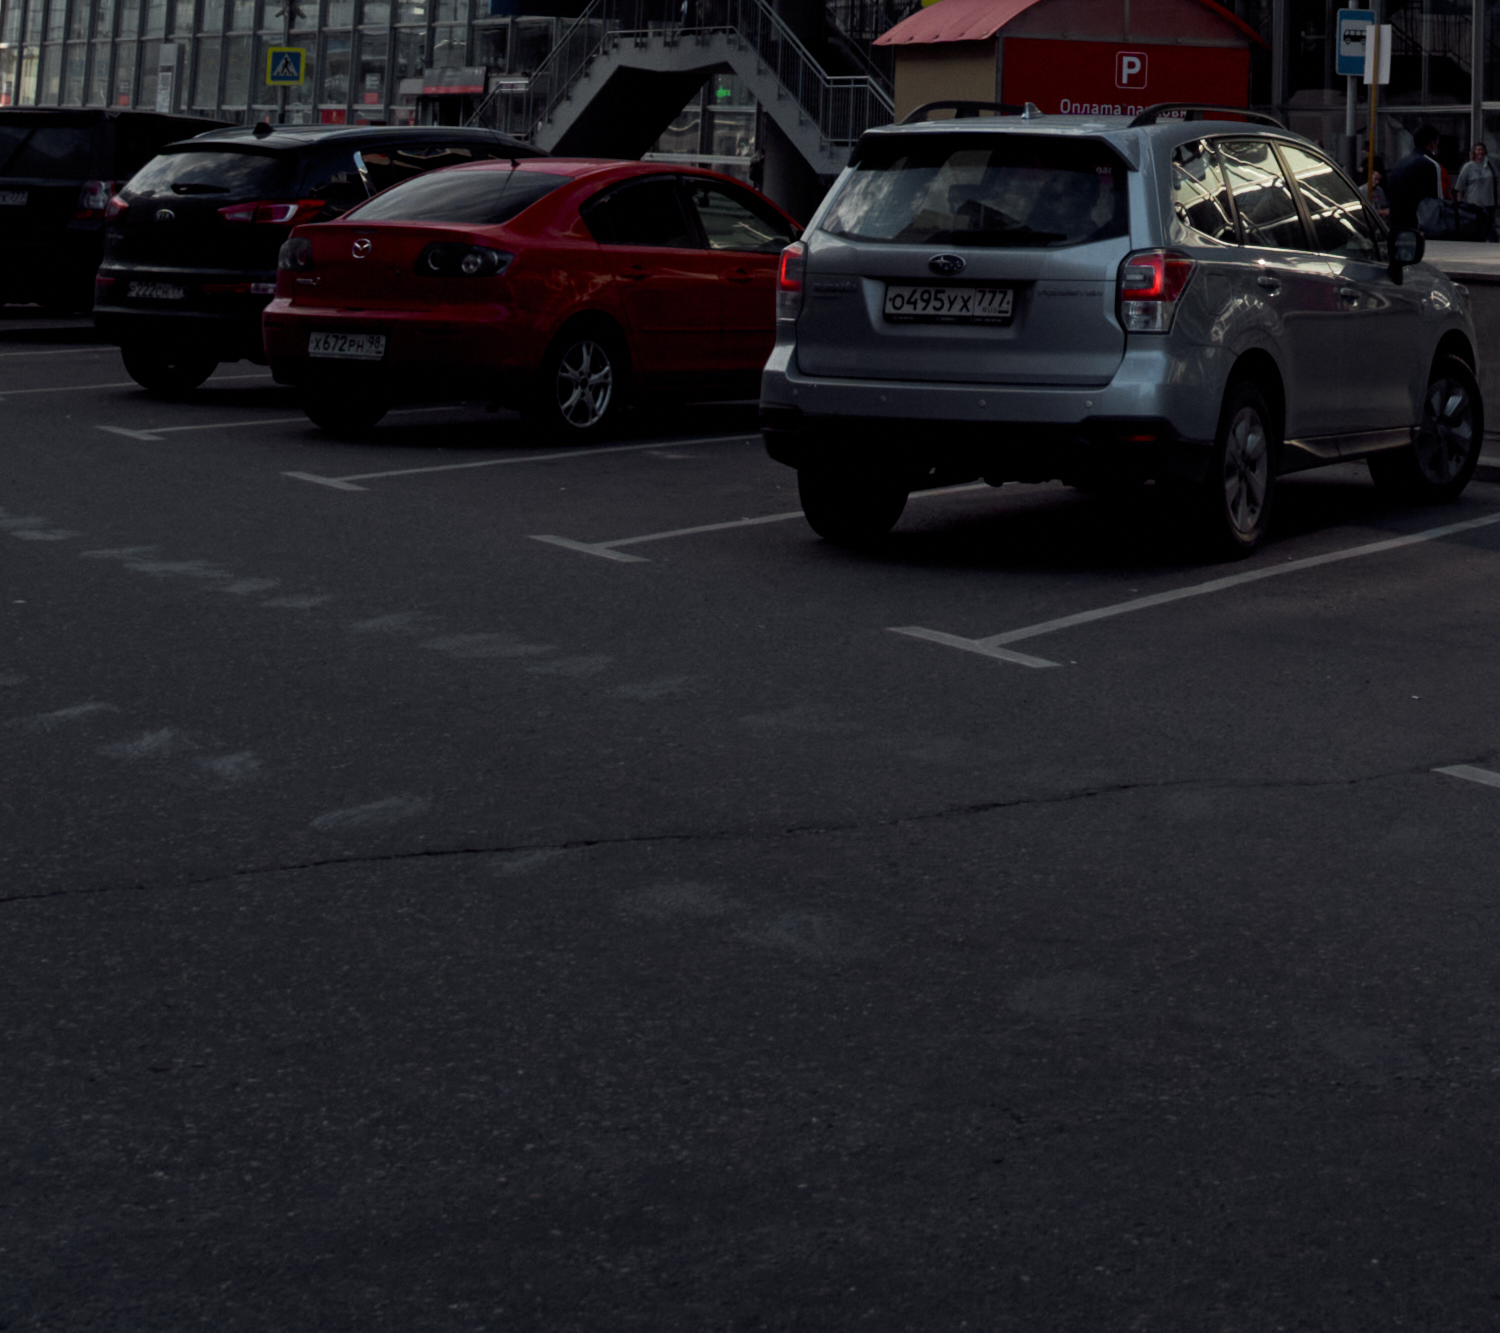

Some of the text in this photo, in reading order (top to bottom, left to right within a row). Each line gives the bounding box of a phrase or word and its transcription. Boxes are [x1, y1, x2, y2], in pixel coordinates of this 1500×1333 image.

[1059, 98, 1122, 116] Оплата
[891, 289, 1008, 313] О495УХ 777
[313, 334, 364, 352] Х672РН
